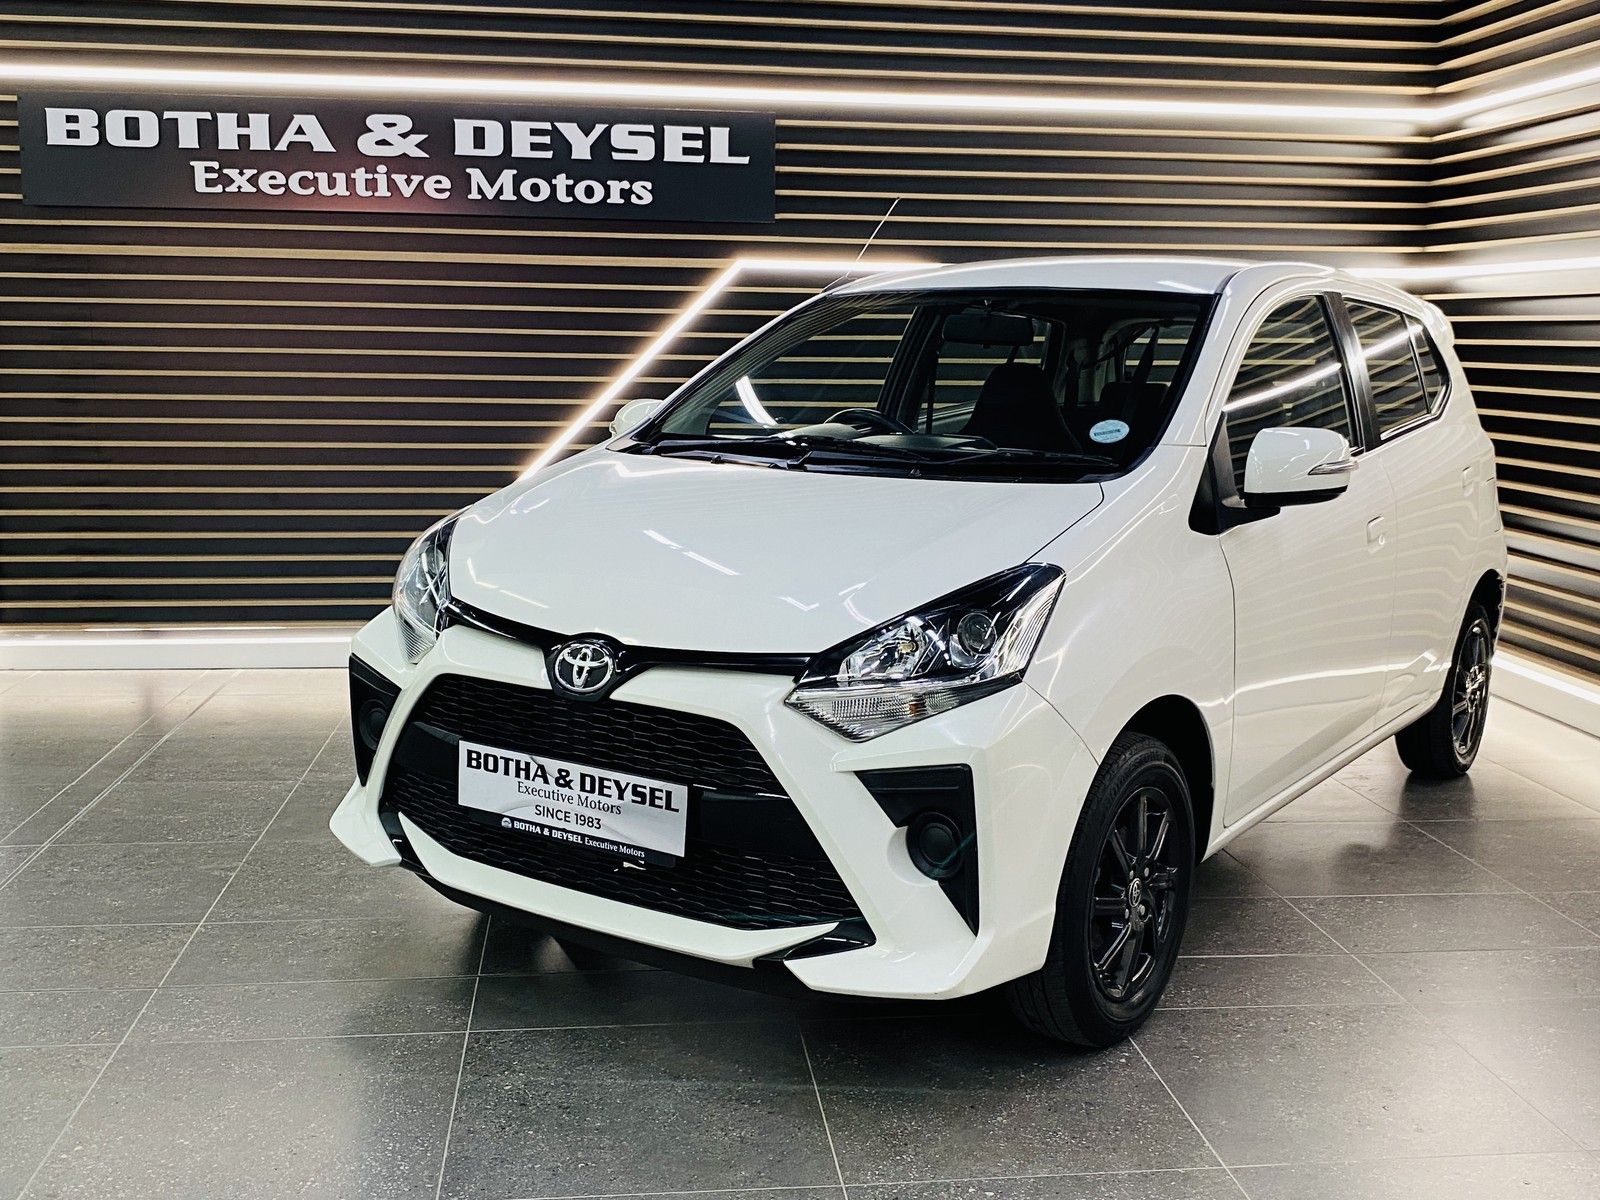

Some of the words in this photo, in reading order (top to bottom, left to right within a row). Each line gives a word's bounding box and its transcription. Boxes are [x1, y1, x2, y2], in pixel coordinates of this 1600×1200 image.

[45, 107, 336, 154] BOTHA
[356, 113, 430, 158] &
[454, 118, 751, 165] DEYSEL
[190, 160, 451, 200] Executive
[467, 167, 654, 206] Motors
[466, 748, 550, 785] BOTHA
[555, 768, 575, 790] &
[580, 771, 680, 813] DEYSEL
[517, 781, 574, 805] Executive
[577, 793, 622, 815] Motors
[534, 804, 571, 823] SINCE
[574, 813, 602, 830] 1983
[513, 820, 541, 835] BOTHA
[543, 827, 550, 836] &
[551, 829, 583, 844] DEYSEL
[584, 837, 618, 852] Executive
[619, 844, 645, 858] Motors
